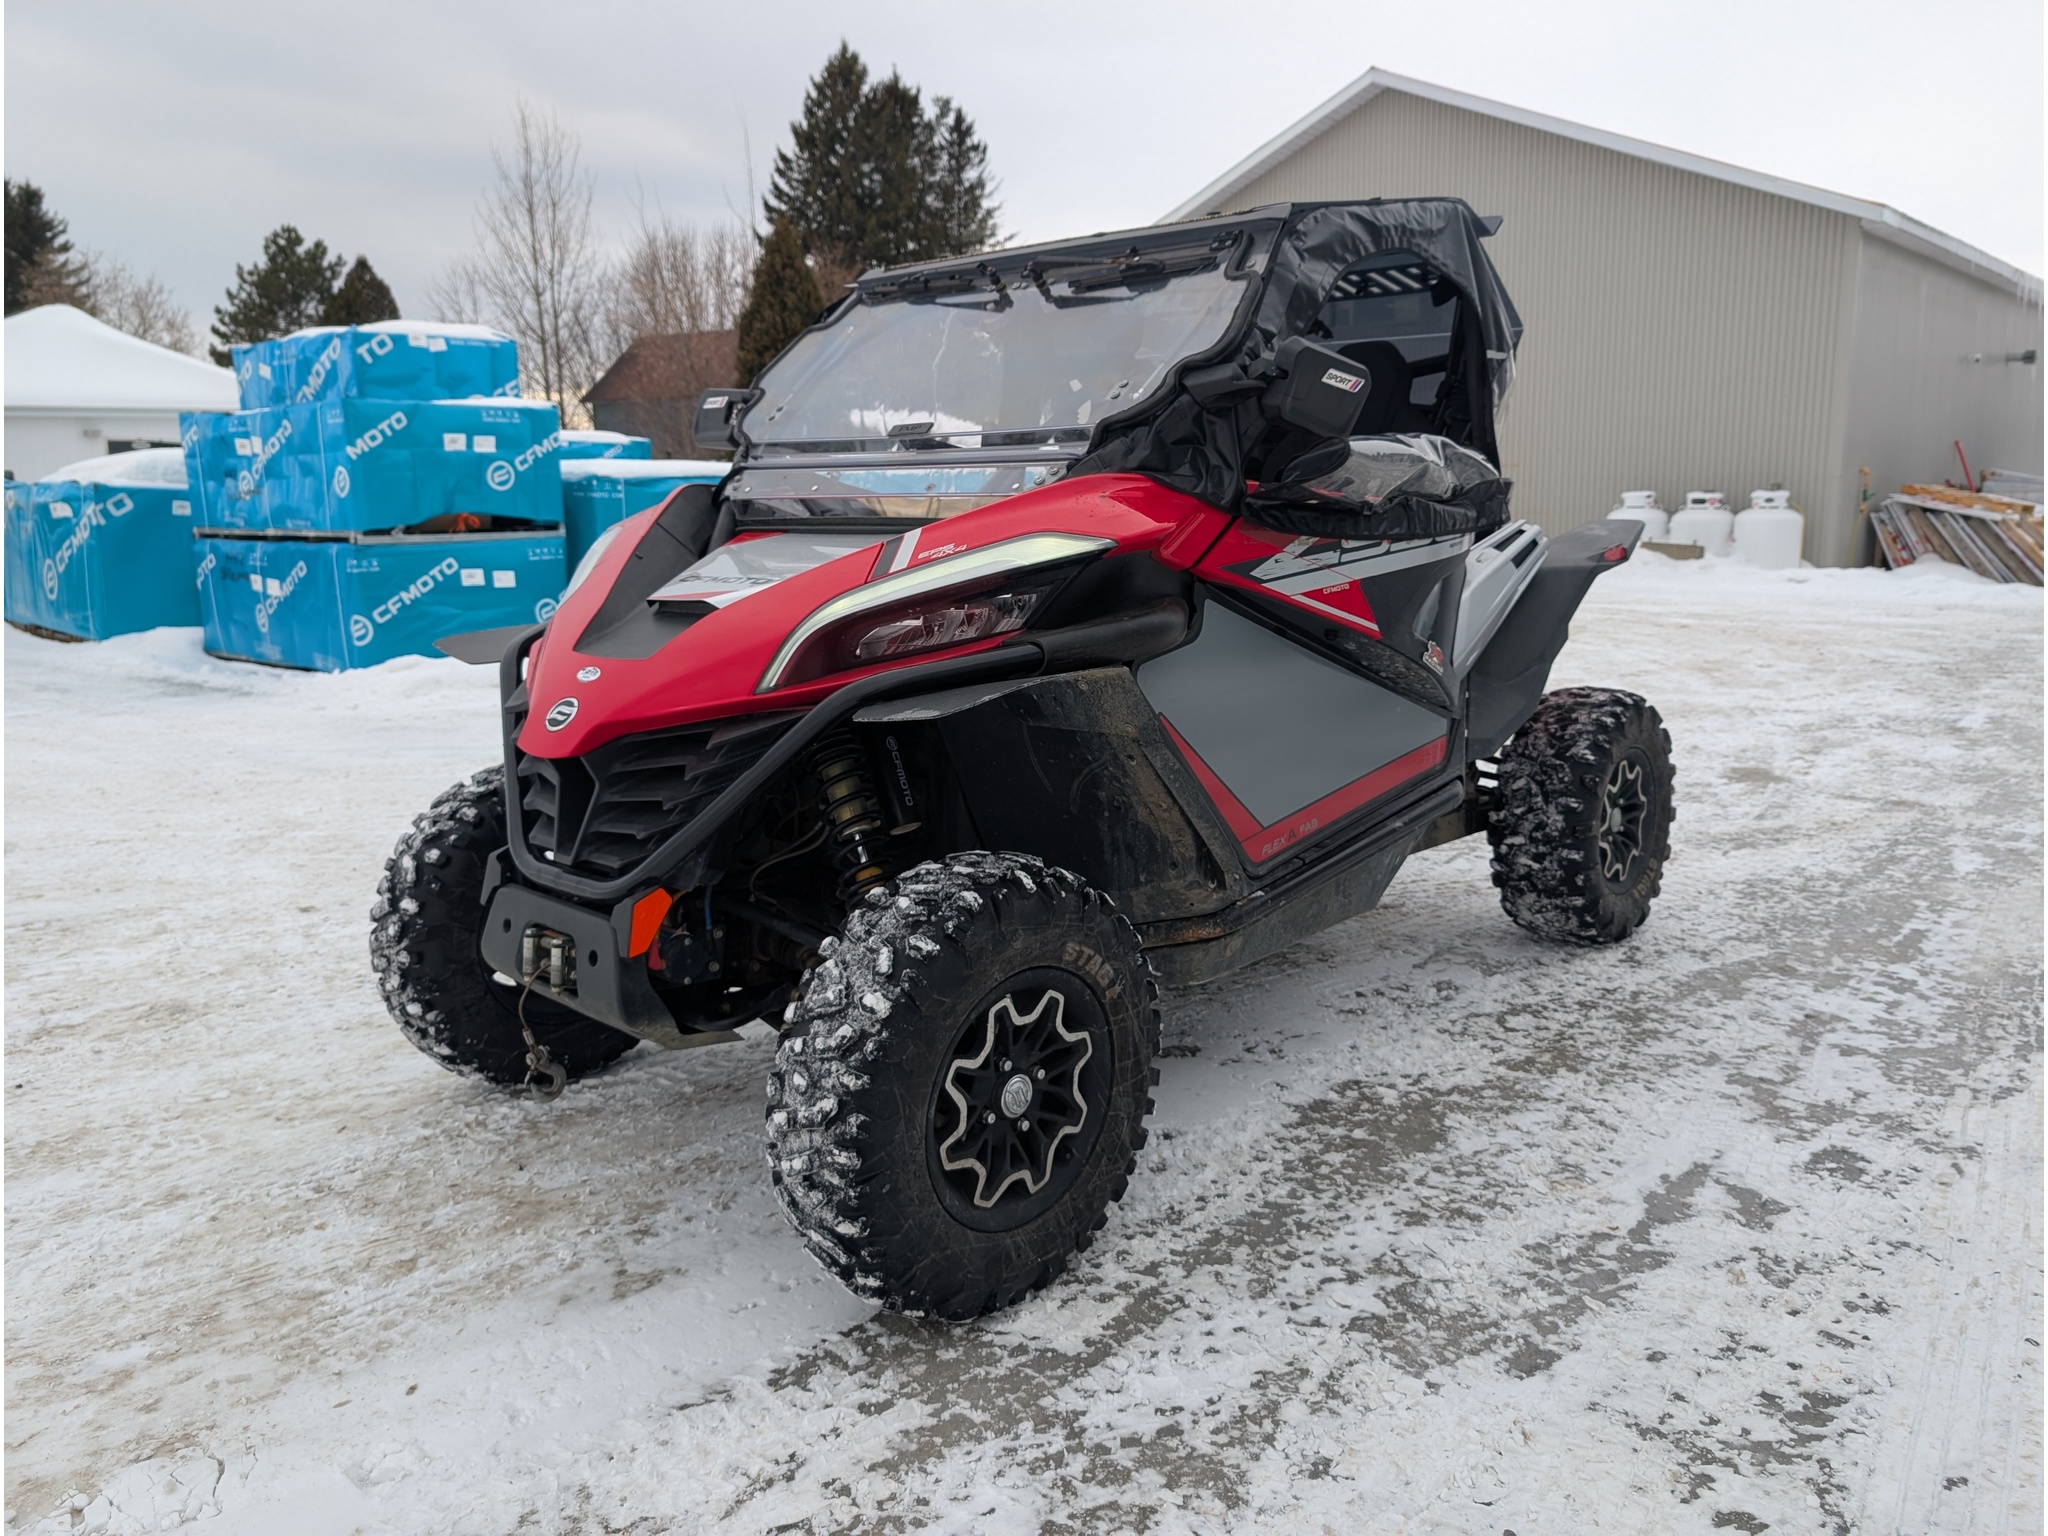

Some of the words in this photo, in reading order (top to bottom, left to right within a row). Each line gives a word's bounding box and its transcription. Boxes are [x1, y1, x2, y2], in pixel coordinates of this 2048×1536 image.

[1326, 373, 1352, 386] SPORT
[918, 543, 955, 559] EPS
[372, 557, 460, 624] CFMOTO
[679, 575, 774, 585] CFMOTO
[1323, 583, 1350, 595] CFMOTO
[892, 751, 914, 806] CFMOTO
[1262, 834, 1287, 856] FLEX
[1299, 818, 1318, 834] FAB
[1062, 943, 1115, 987] STAG
